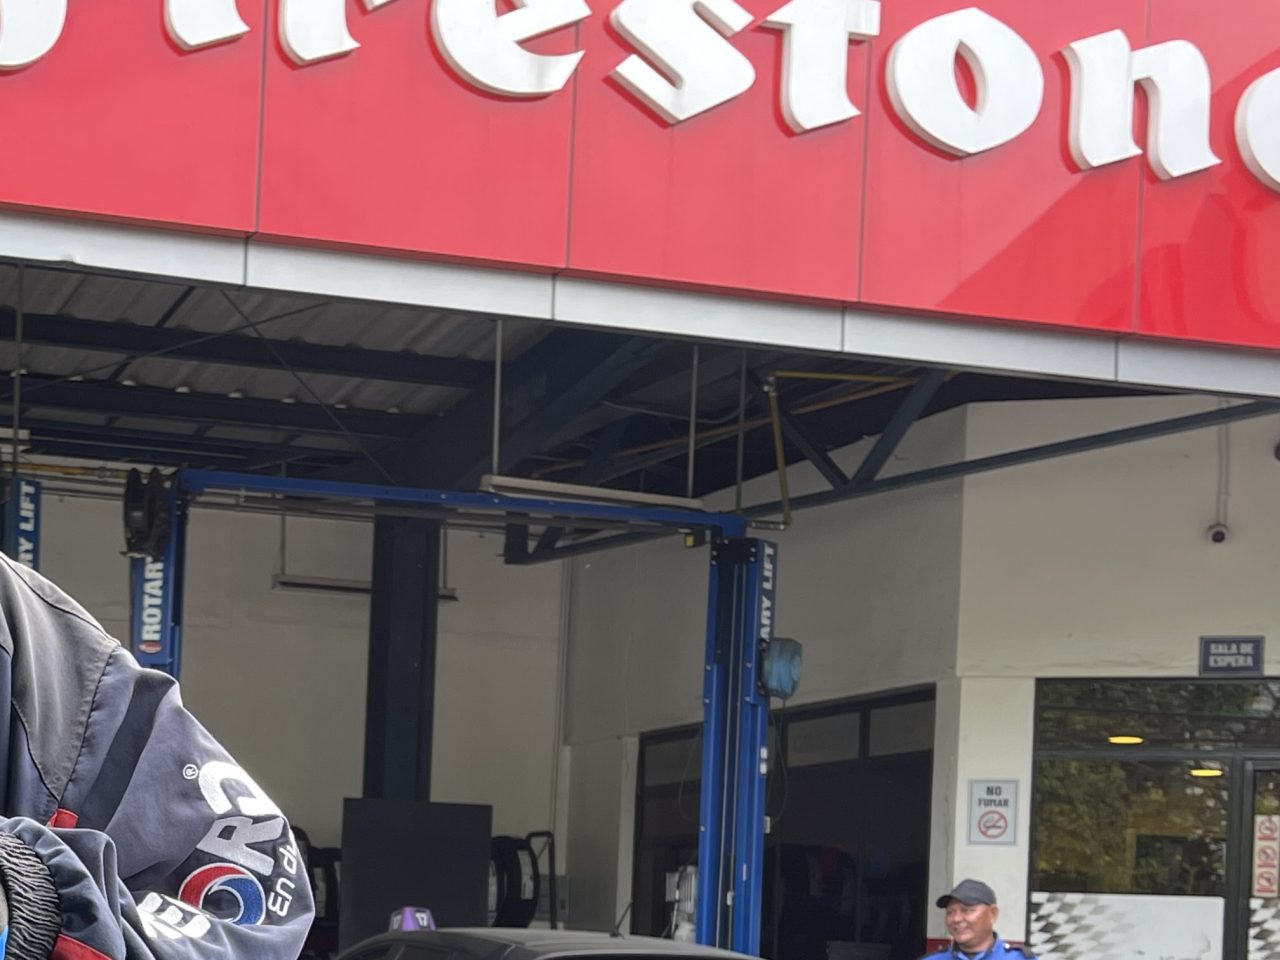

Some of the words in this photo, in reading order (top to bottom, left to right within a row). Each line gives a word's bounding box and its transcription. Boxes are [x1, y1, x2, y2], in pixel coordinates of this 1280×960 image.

[20, 480, 36, 532] LIFT
[762, 543, 774, 591] LIFT
[142, 556, 164, 641] ROTAR
[760, 596, 772, 642] ARY
[1209, 655, 1254, 668] ESPERA
[1210, 643, 1238, 655] SALA
[1239, 643, 1254, 654] DE
[978, 798, 1010, 808] FUMAR
[985, 785, 1003, 797] NO
